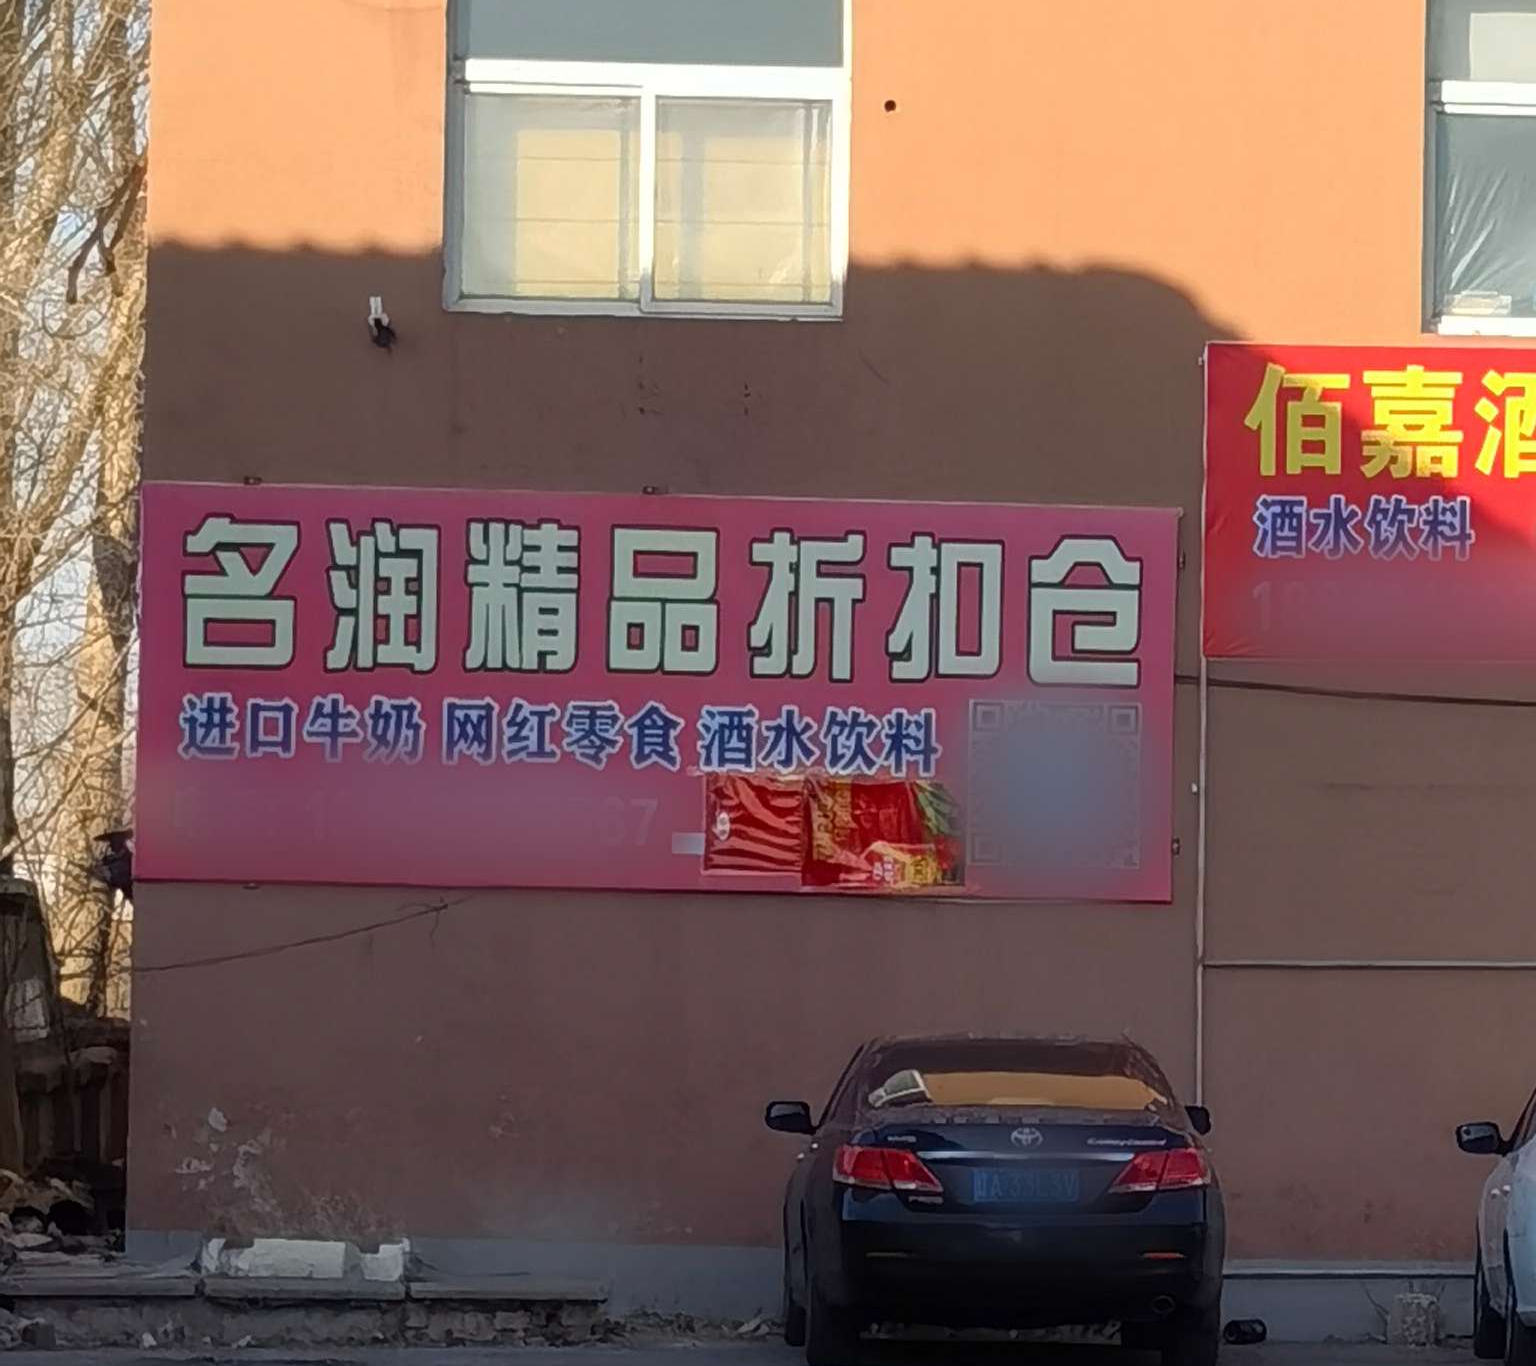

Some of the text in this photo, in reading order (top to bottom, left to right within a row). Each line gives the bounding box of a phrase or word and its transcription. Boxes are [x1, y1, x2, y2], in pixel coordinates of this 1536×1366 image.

[1252, 495, 1474, 561] 酒水饮料
[179, 516, 1143, 687] 名润精品折扣仓
[177, 692, 942, 778] 进口牛奶 网红零食 酒水饮料
